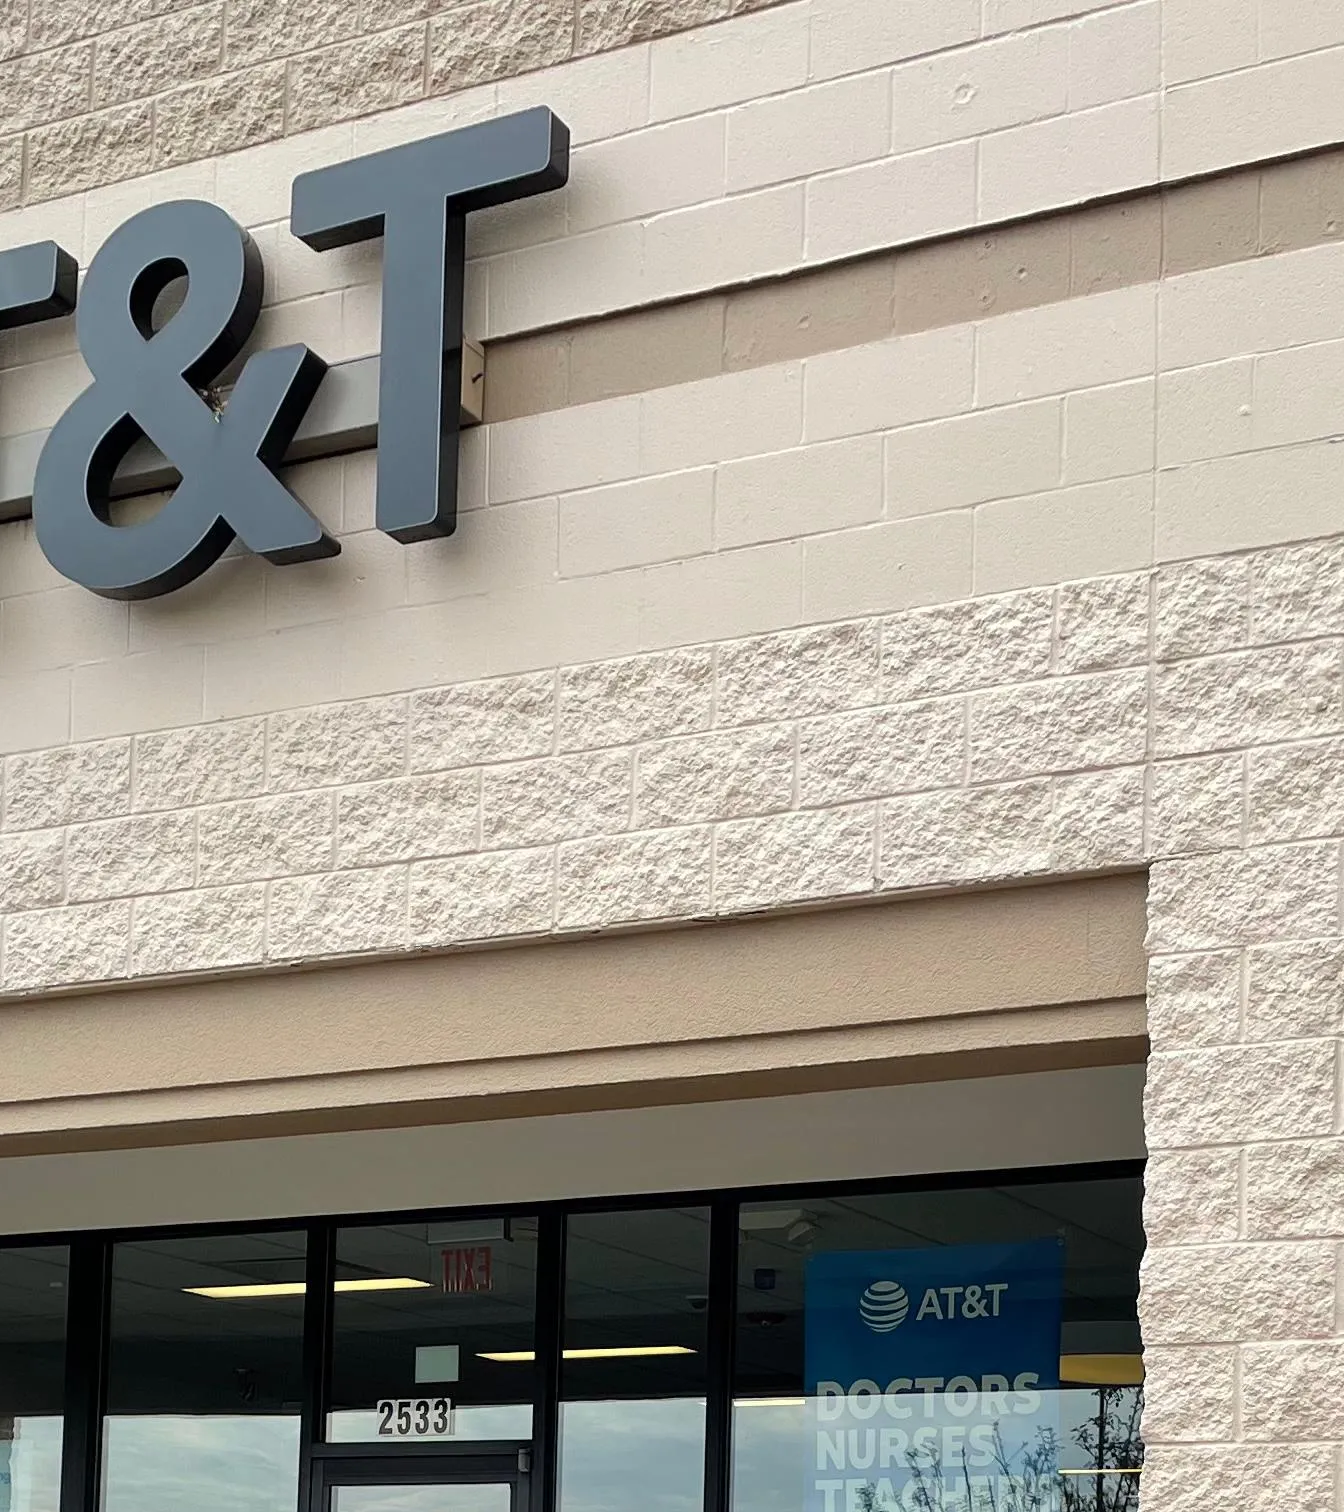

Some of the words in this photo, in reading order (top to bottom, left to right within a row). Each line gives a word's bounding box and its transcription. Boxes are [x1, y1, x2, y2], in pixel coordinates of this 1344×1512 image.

[915, 1283, 1009, 1322] AT&T
[378, 1400, 449, 1435] 2533
[816, 1372, 1042, 1422] DOCTORS
[816, 1424, 996, 1471] NURSES
